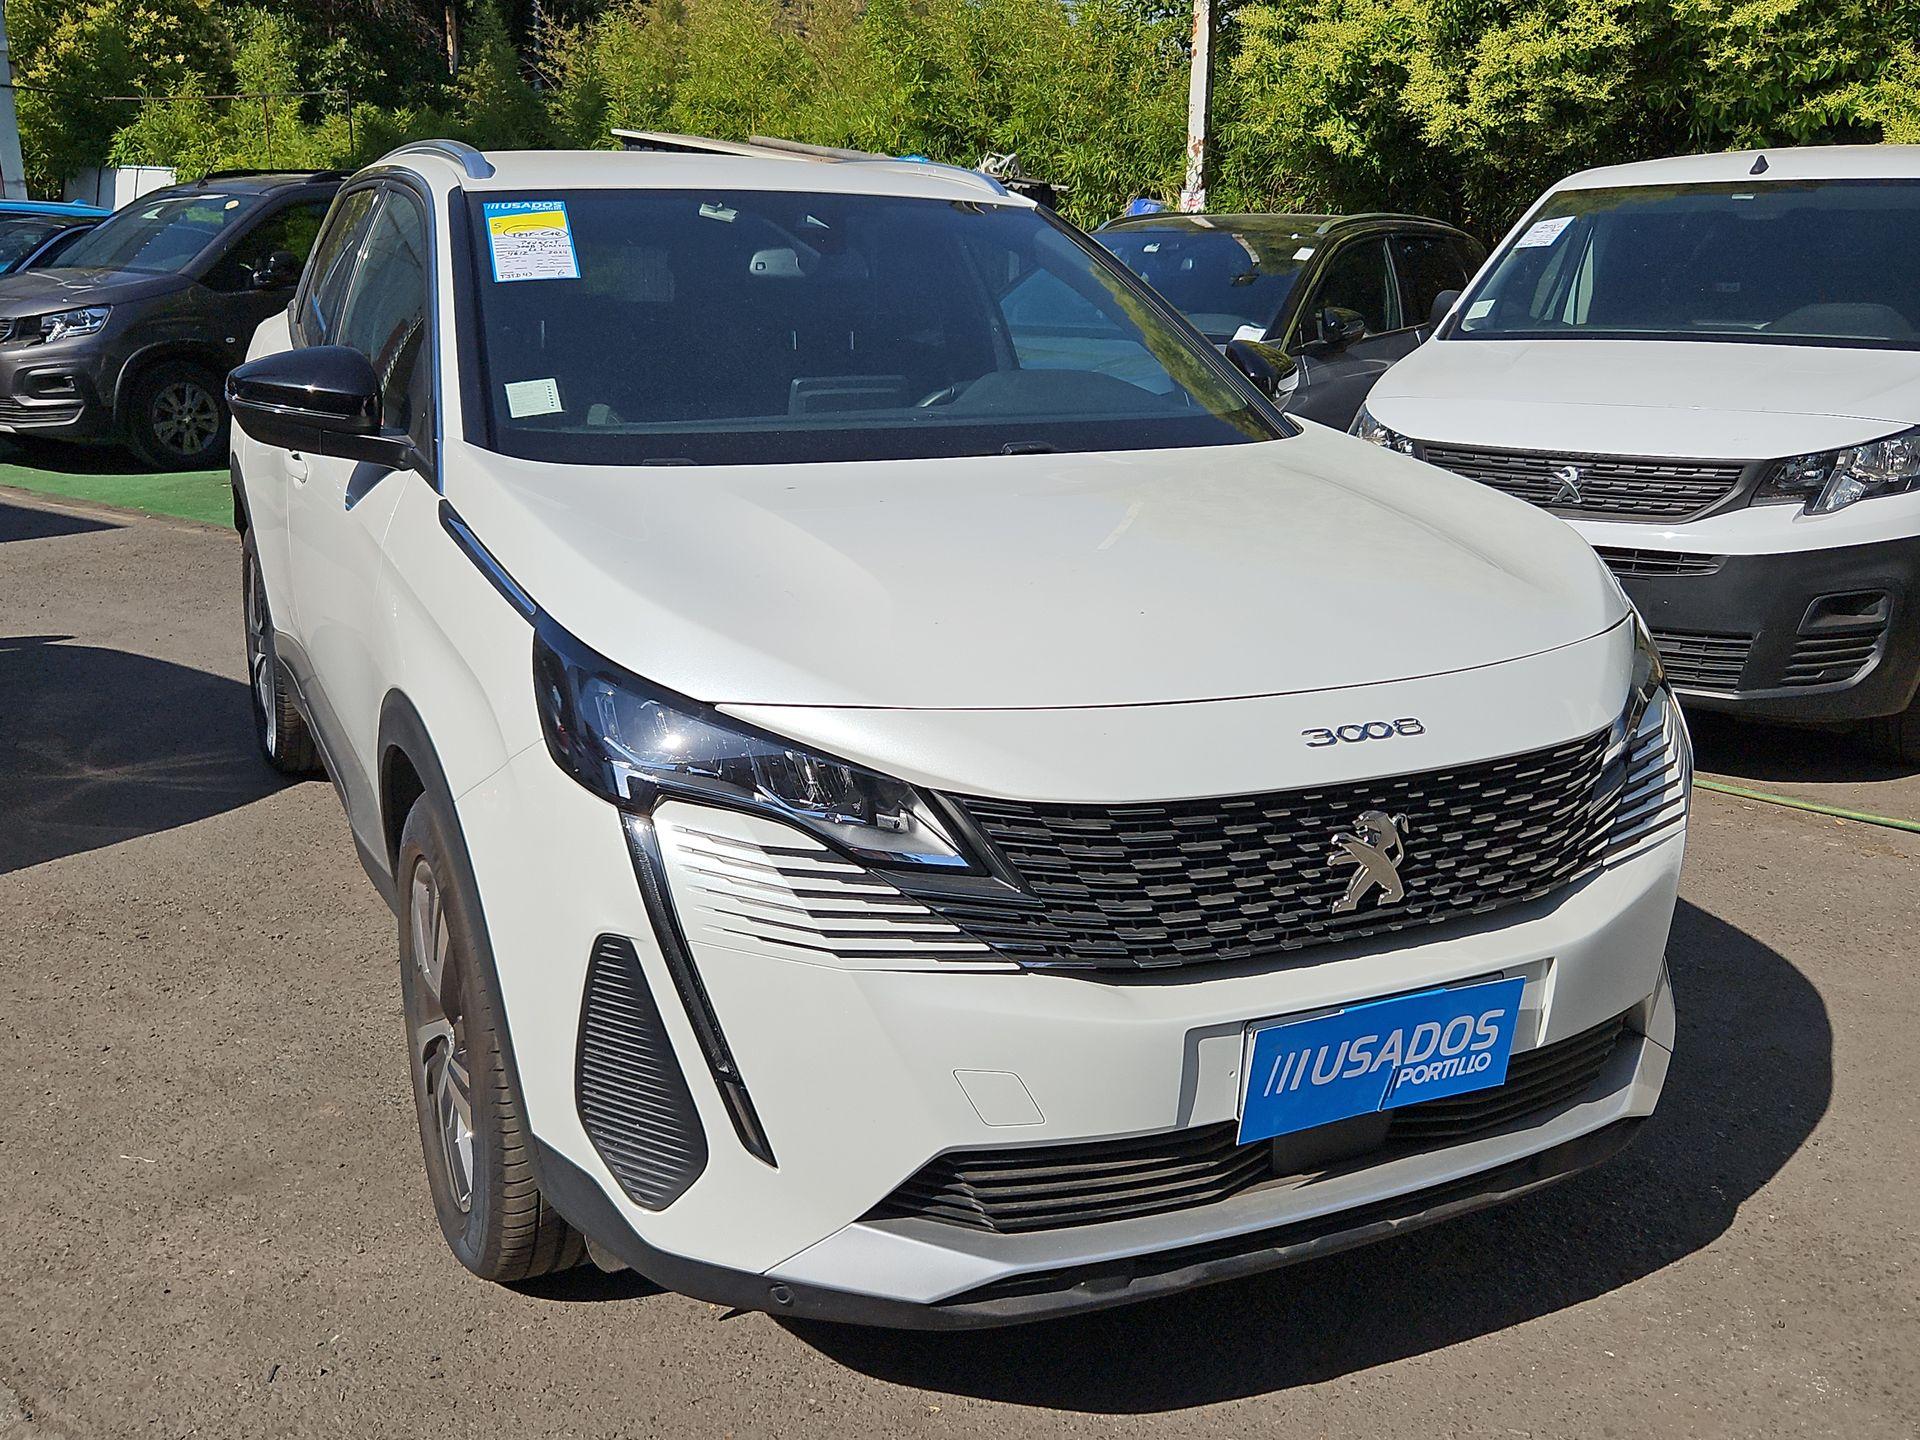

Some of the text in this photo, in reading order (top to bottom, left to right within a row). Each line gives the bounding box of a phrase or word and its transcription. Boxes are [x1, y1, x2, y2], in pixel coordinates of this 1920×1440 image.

[1301, 718, 1425, 747] 3008
[1311, 1009, 1505, 1085] USADOS
[1396, 1052, 1491, 1089] PORTILLO
